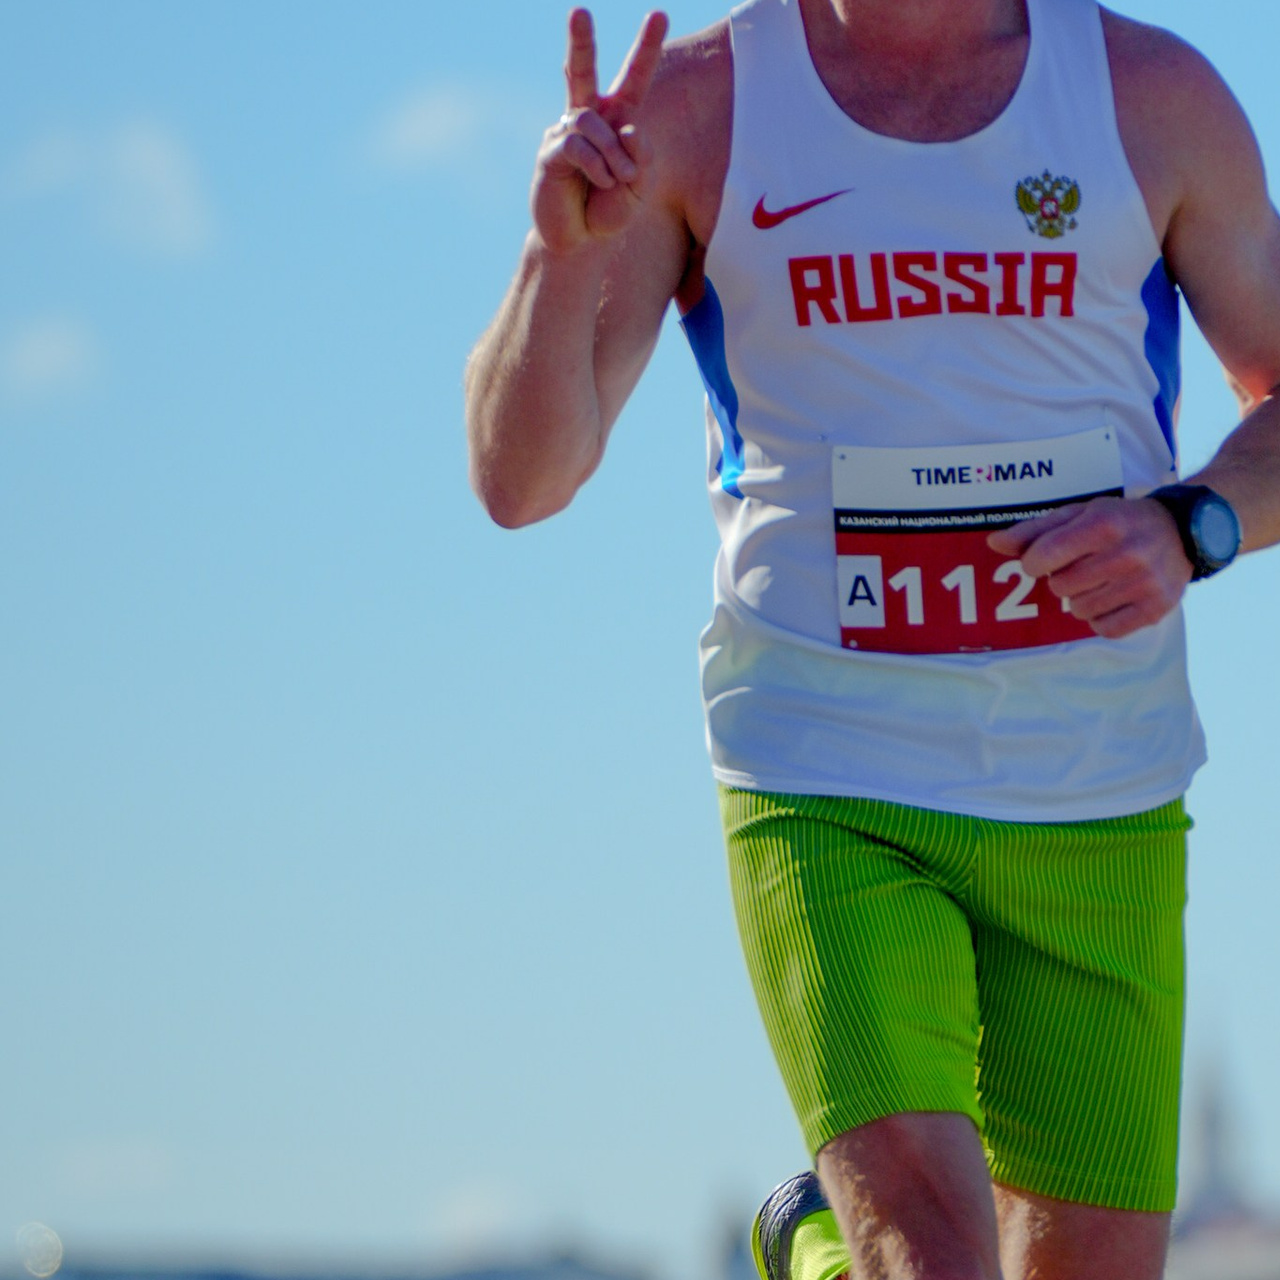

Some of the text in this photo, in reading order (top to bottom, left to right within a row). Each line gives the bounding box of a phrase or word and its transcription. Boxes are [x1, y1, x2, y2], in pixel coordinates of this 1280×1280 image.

[788, 251, 1078, 327] RUSSIA
[839, 515, 899, 527] КАЗАНСКИЙ
[900, 513, 986, 528] НАЦИОНАЛЬНЫЙ
[888, 559, 1072, 626] 112
